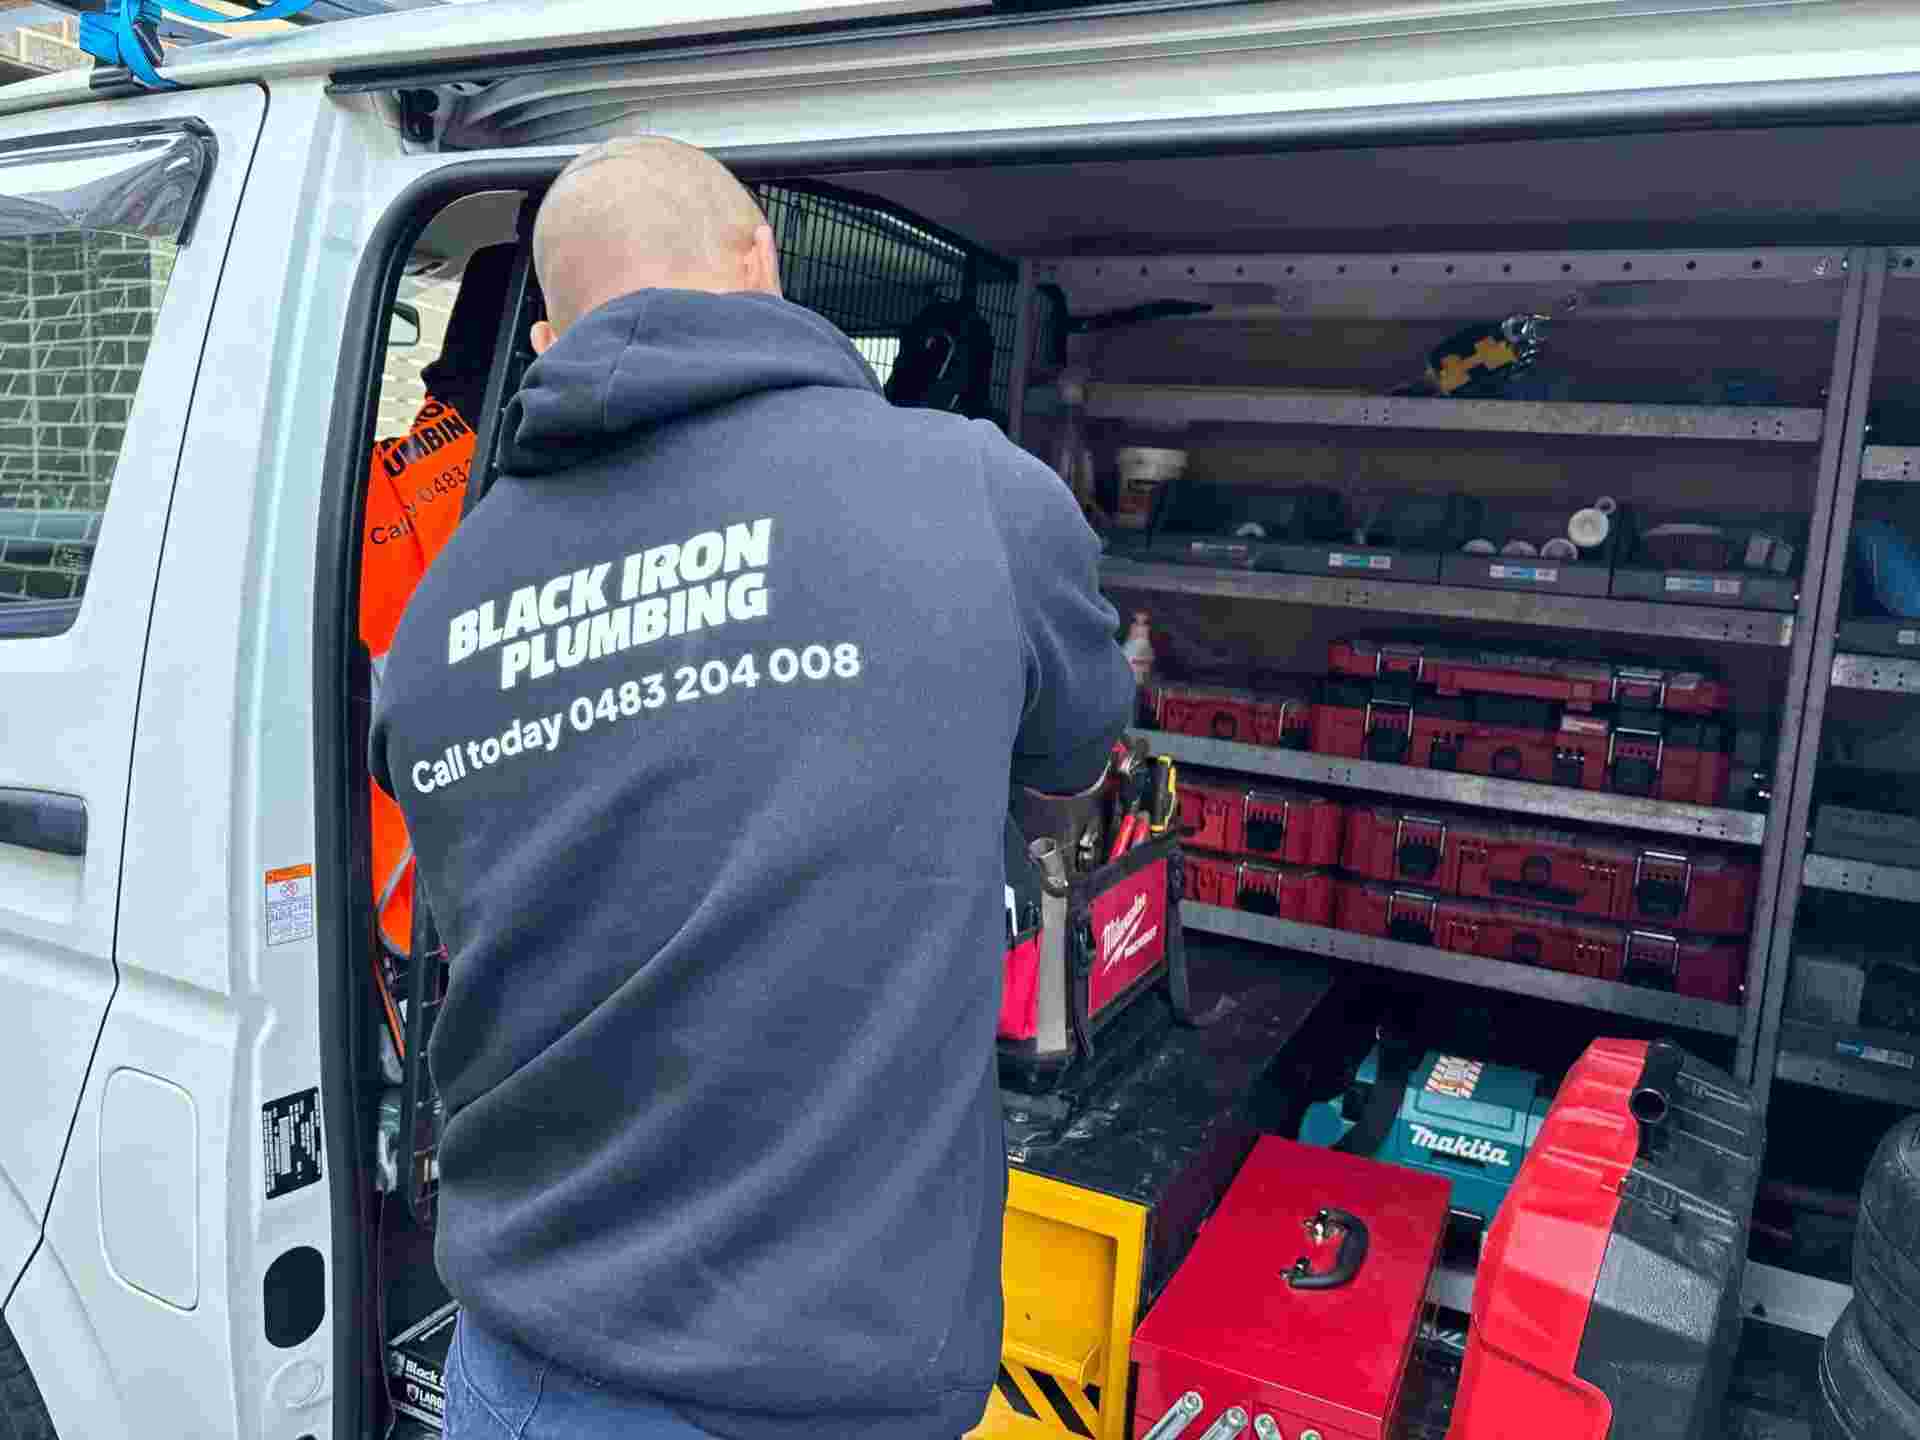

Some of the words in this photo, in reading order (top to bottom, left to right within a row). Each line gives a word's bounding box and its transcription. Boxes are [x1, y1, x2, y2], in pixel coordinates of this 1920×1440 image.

[448, 562, 612, 665] BLACK
[621, 518, 772, 601] IRON
[500, 573, 769, 690] PLUMBING
[412, 746, 466, 793] Call
[467, 711, 563, 769] today
[570, 673, 666, 731] 0483
[674, 653, 761, 702] 204
[769, 642, 861, 683] 008
